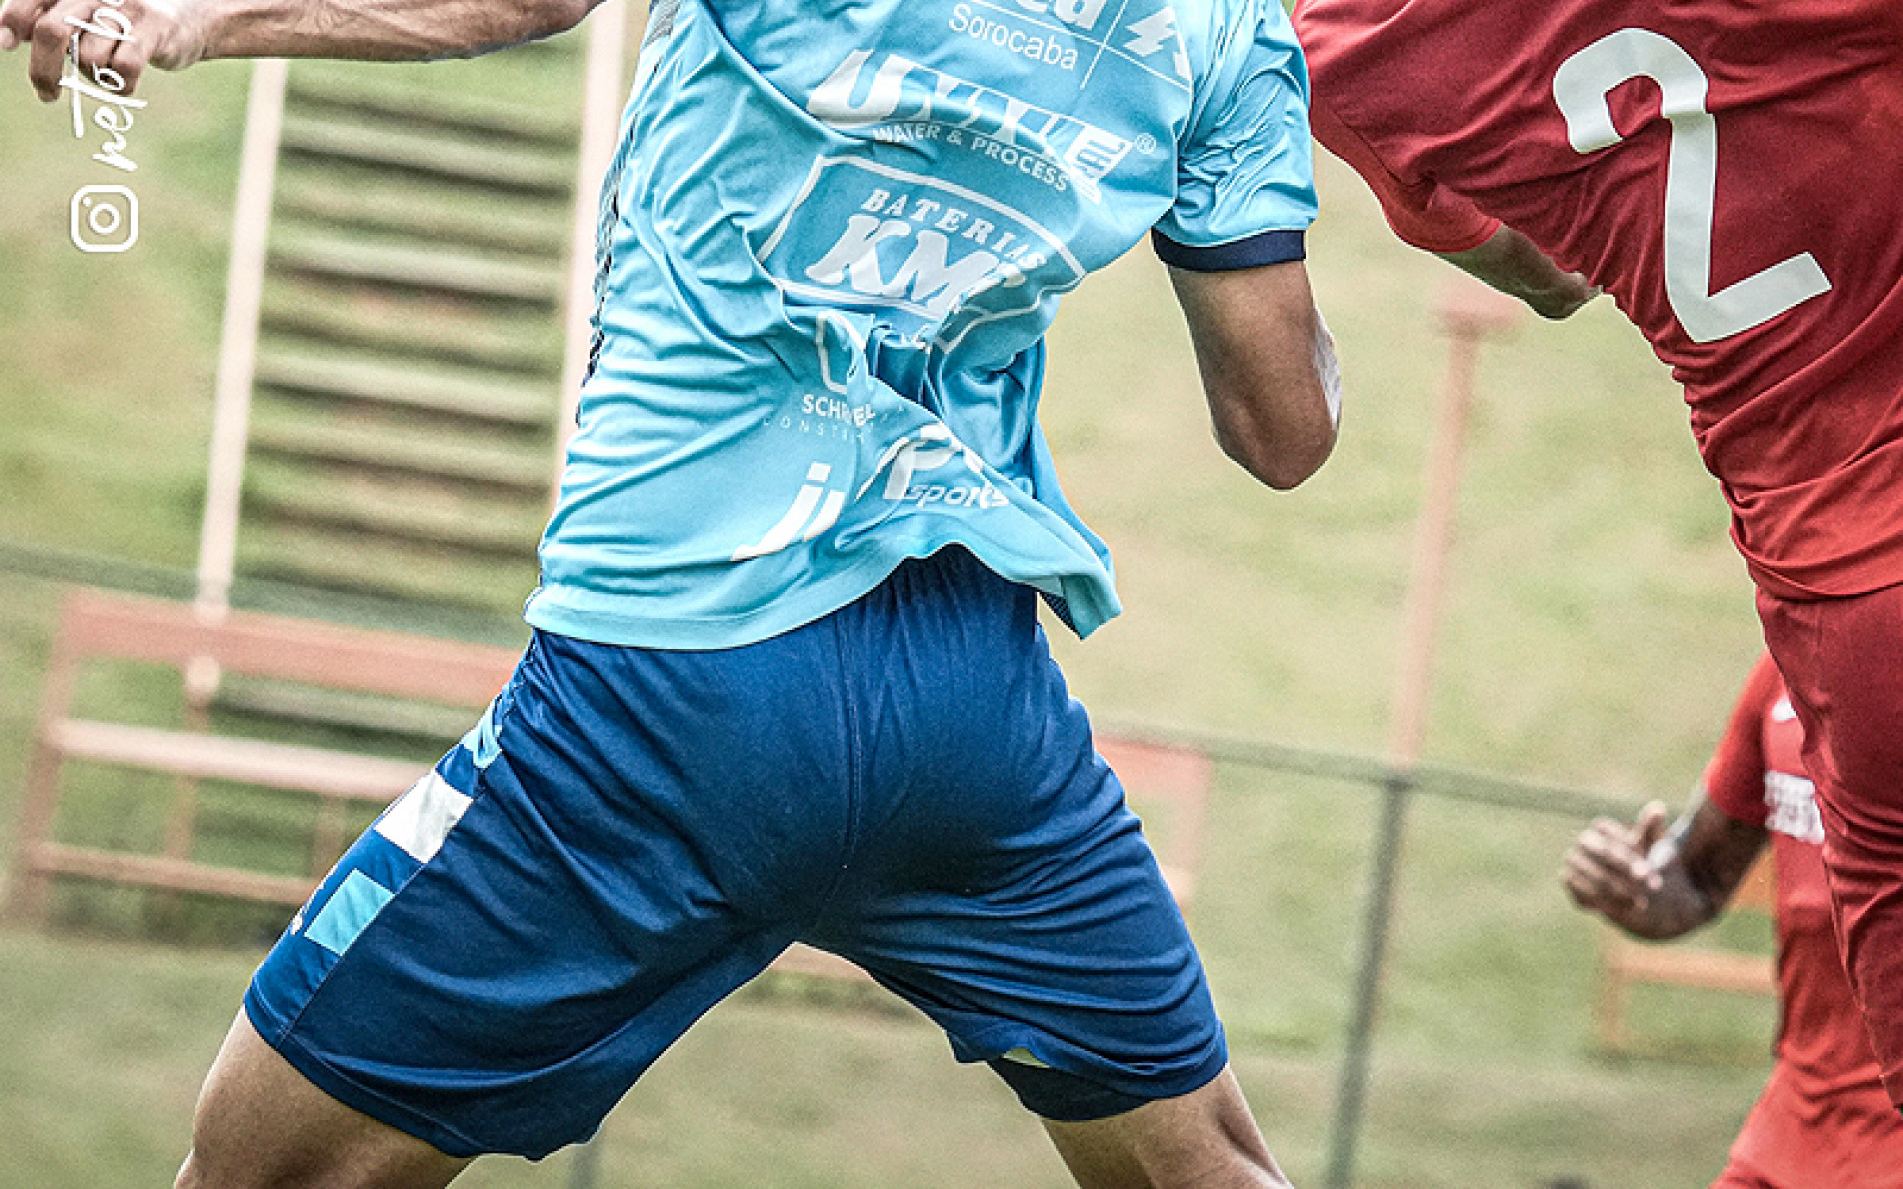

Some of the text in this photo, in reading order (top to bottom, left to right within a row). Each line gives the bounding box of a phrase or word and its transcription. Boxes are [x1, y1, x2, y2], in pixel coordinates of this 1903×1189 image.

[949, 3, 1079, 70] Sorocaba
[873, 122, 1071, 191] WATER & PROCESS
[1553, 28, 1833, 343] 2
